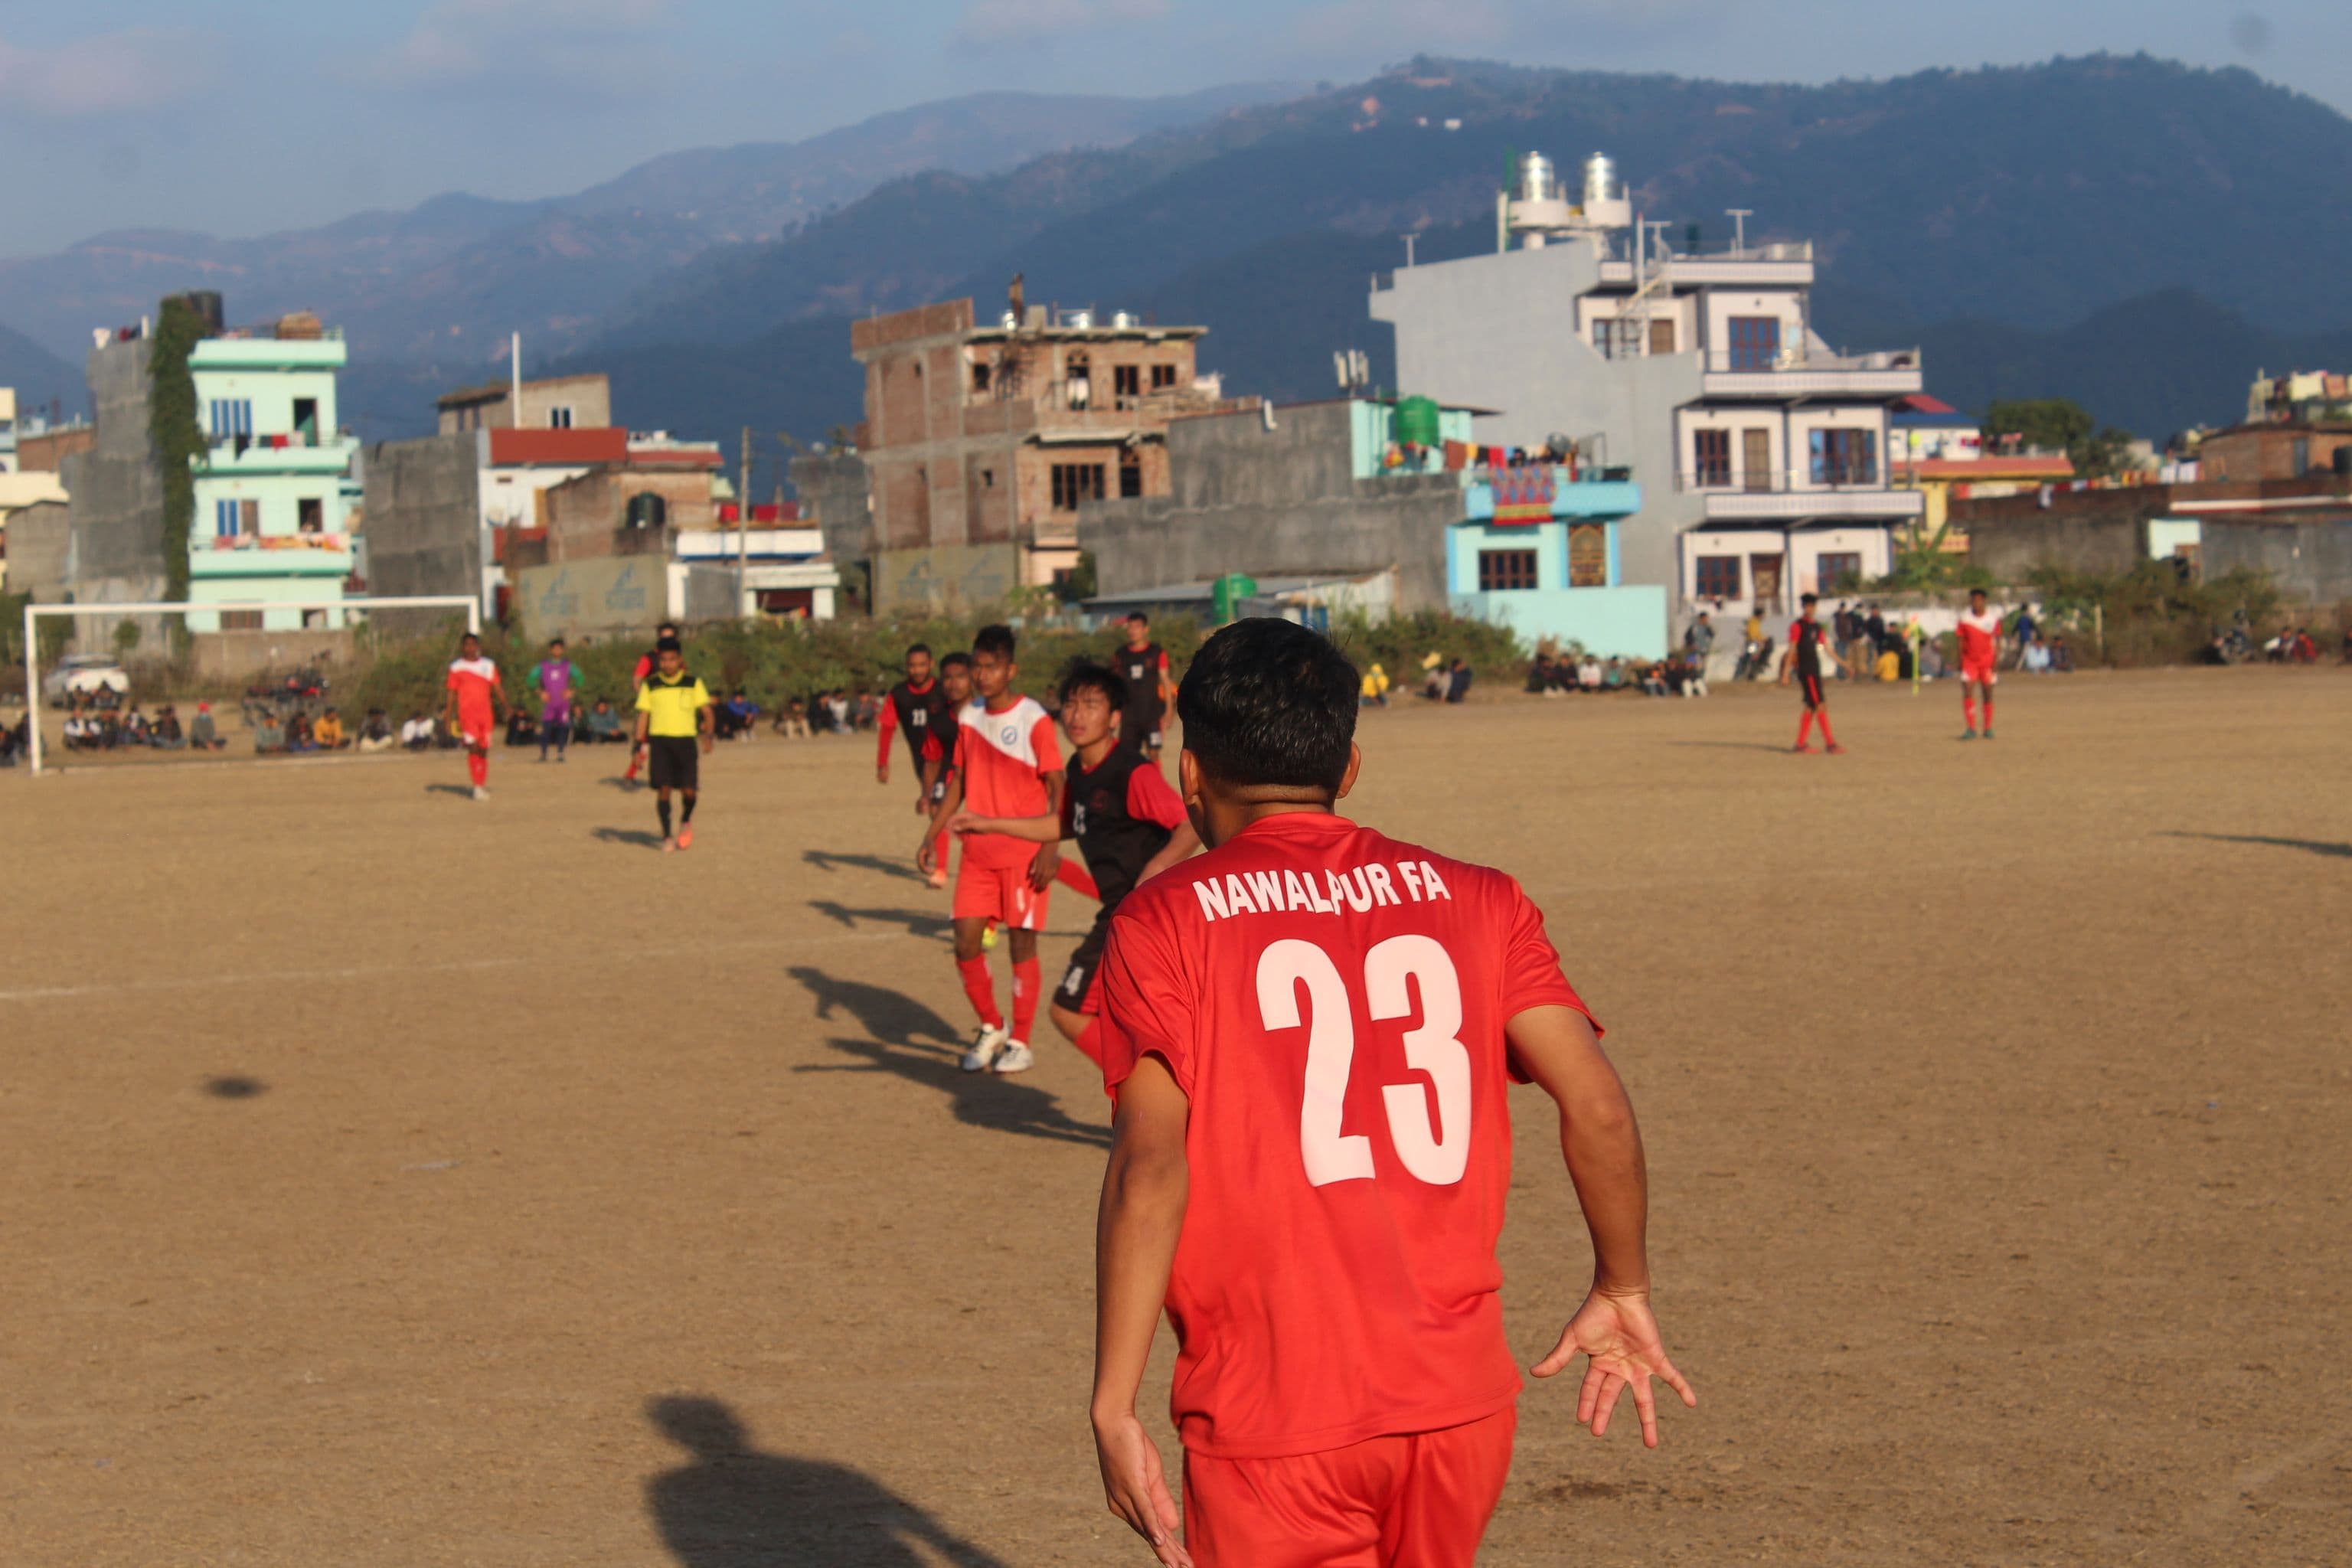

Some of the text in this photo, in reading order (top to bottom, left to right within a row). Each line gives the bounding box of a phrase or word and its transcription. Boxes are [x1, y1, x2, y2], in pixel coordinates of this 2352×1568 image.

[1192, 861, 1451, 921] NAWALPUR FA
[1256, 934, 1471, 1187] 23
